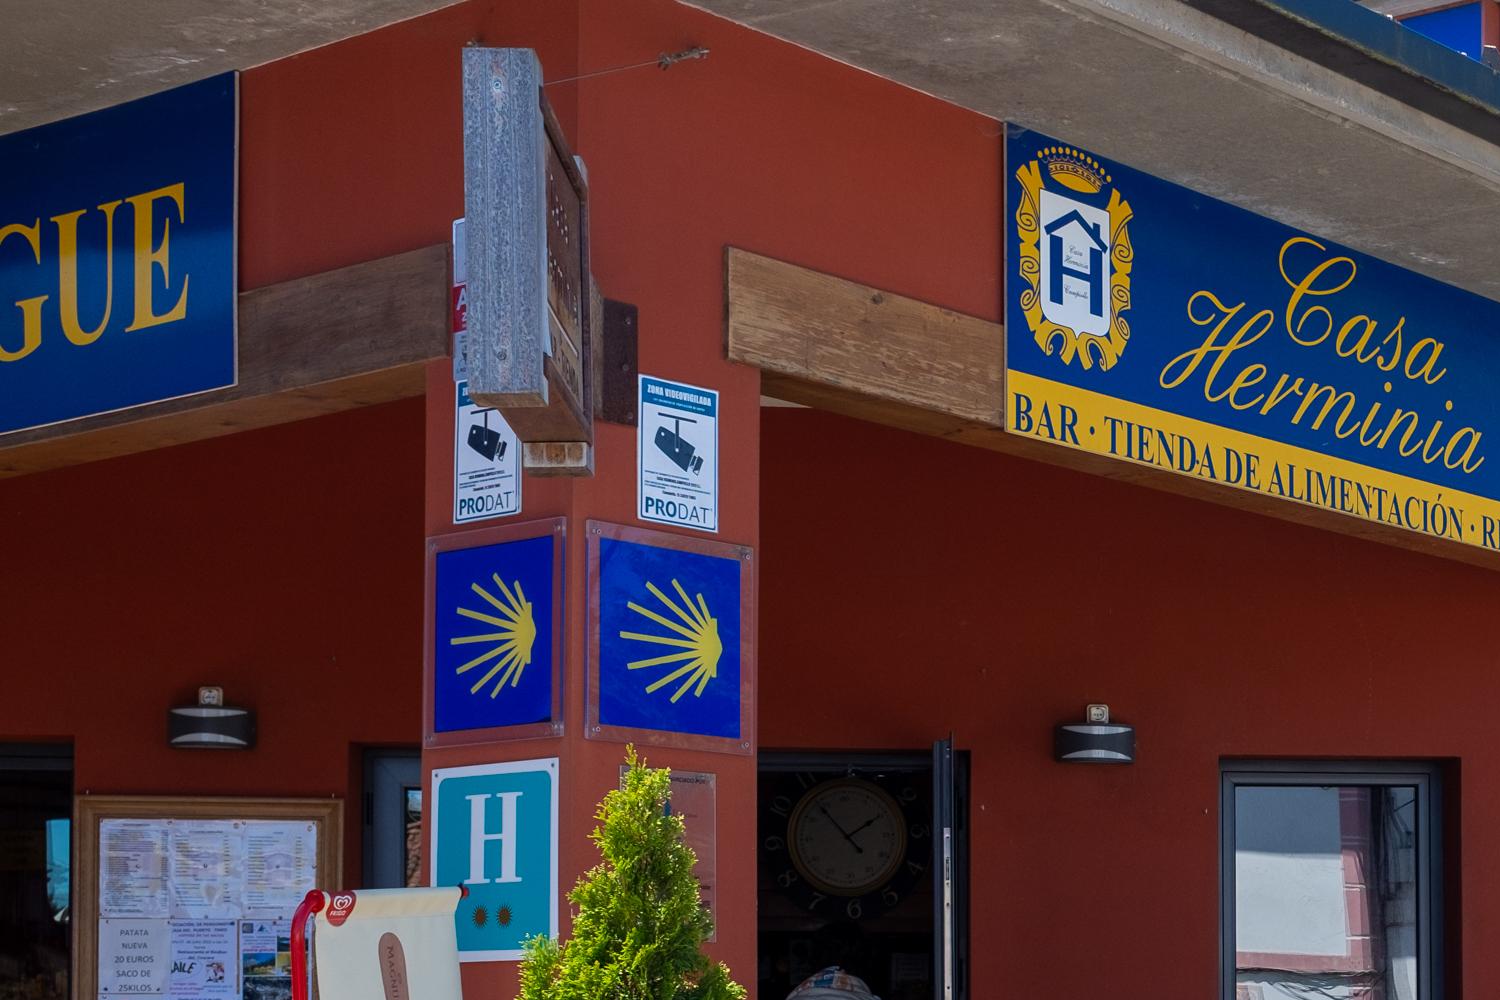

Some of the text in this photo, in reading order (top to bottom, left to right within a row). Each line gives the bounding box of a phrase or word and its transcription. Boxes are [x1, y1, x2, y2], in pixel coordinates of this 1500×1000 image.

[0, 182, 189, 362] GUE
[1279, 237, 1447, 385] Casa
[1159, 290, 1484, 475] Herminia
[647, 384, 664, 397] ZONA
[665, 388, 712, 407] VIDEOVIGILADA
[1013, 392, 1080, 446] BAR
[1104, 415, 1218, 481] TIENDA
[1223, 448, 1260, 486] DE
[1267, 467, 1464, 542] ALIMENTACIÓN
[459, 492, 511, 516] PRODAT
[645, 496, 710, 524] PRODAT
[464, 791, 524, 885] H
[122, 942, 148, 950] NUEVA
[114, 956, 125, 964] 20
[171, 961, 197, 974] AILE
[116, 969, 151, 977] SACO DE
[118, 984, 152, 992] 25KILOS
